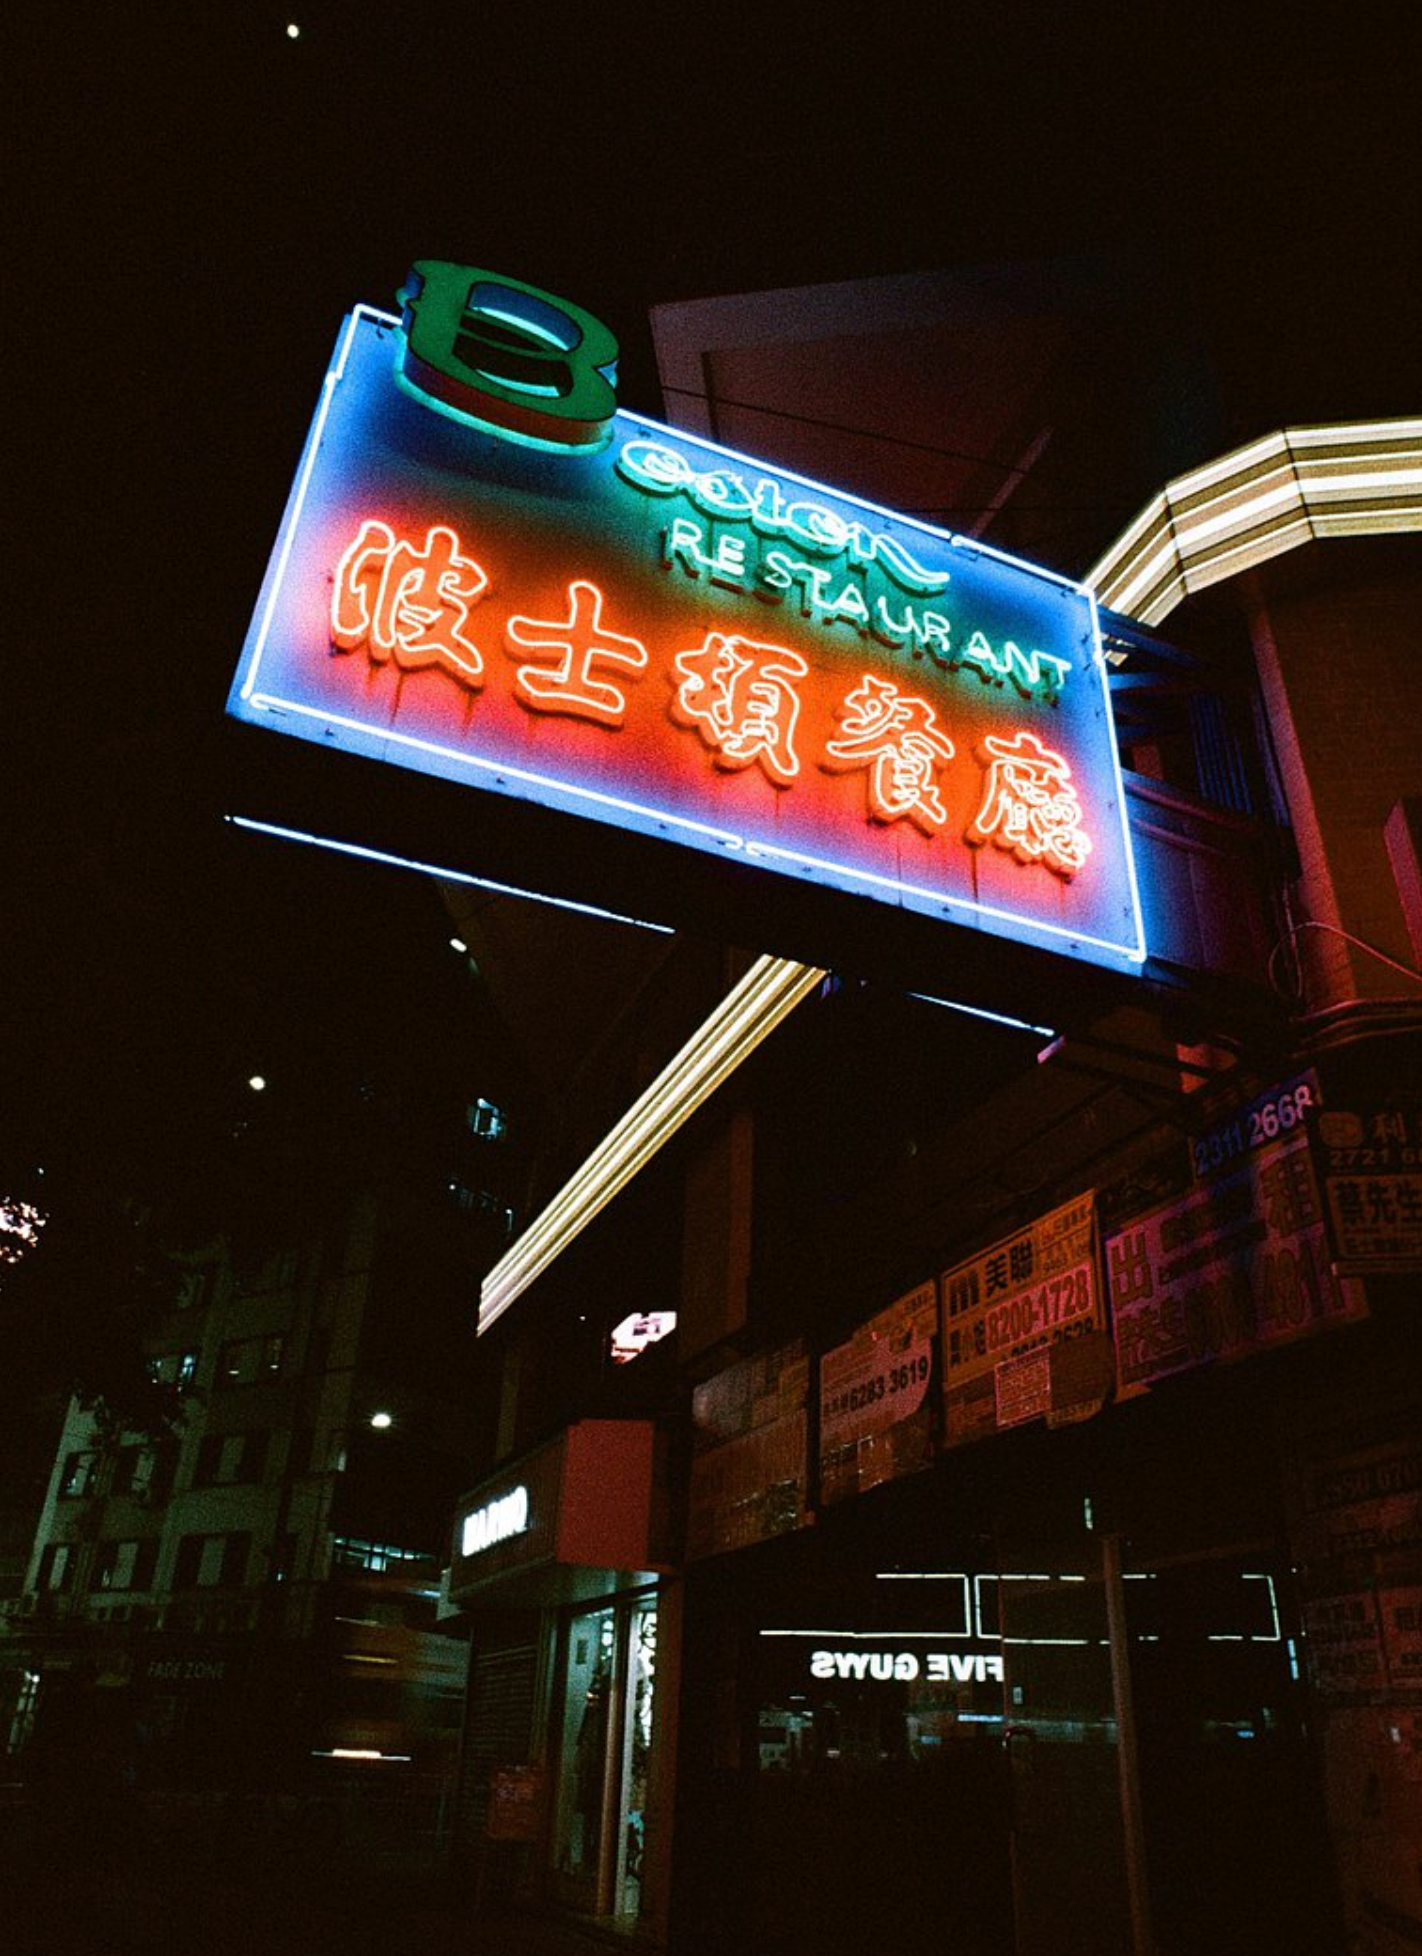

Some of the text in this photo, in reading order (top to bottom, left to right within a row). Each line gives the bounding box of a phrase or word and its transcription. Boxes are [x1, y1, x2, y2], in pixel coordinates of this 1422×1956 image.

[666, 517, 1073, 692] RESTAURANT
[330, 519, 1094, 870] 波士頓餐廳
[1330, 1147, 1391, 1167] 2721
[985, 1238, 1033, 1298] 美聯
[988, 1269, 1089, 1350] 8200-1728
[850, 1375, 884, 1412] 6283
[888, 1355, 928, 1394] 3619
